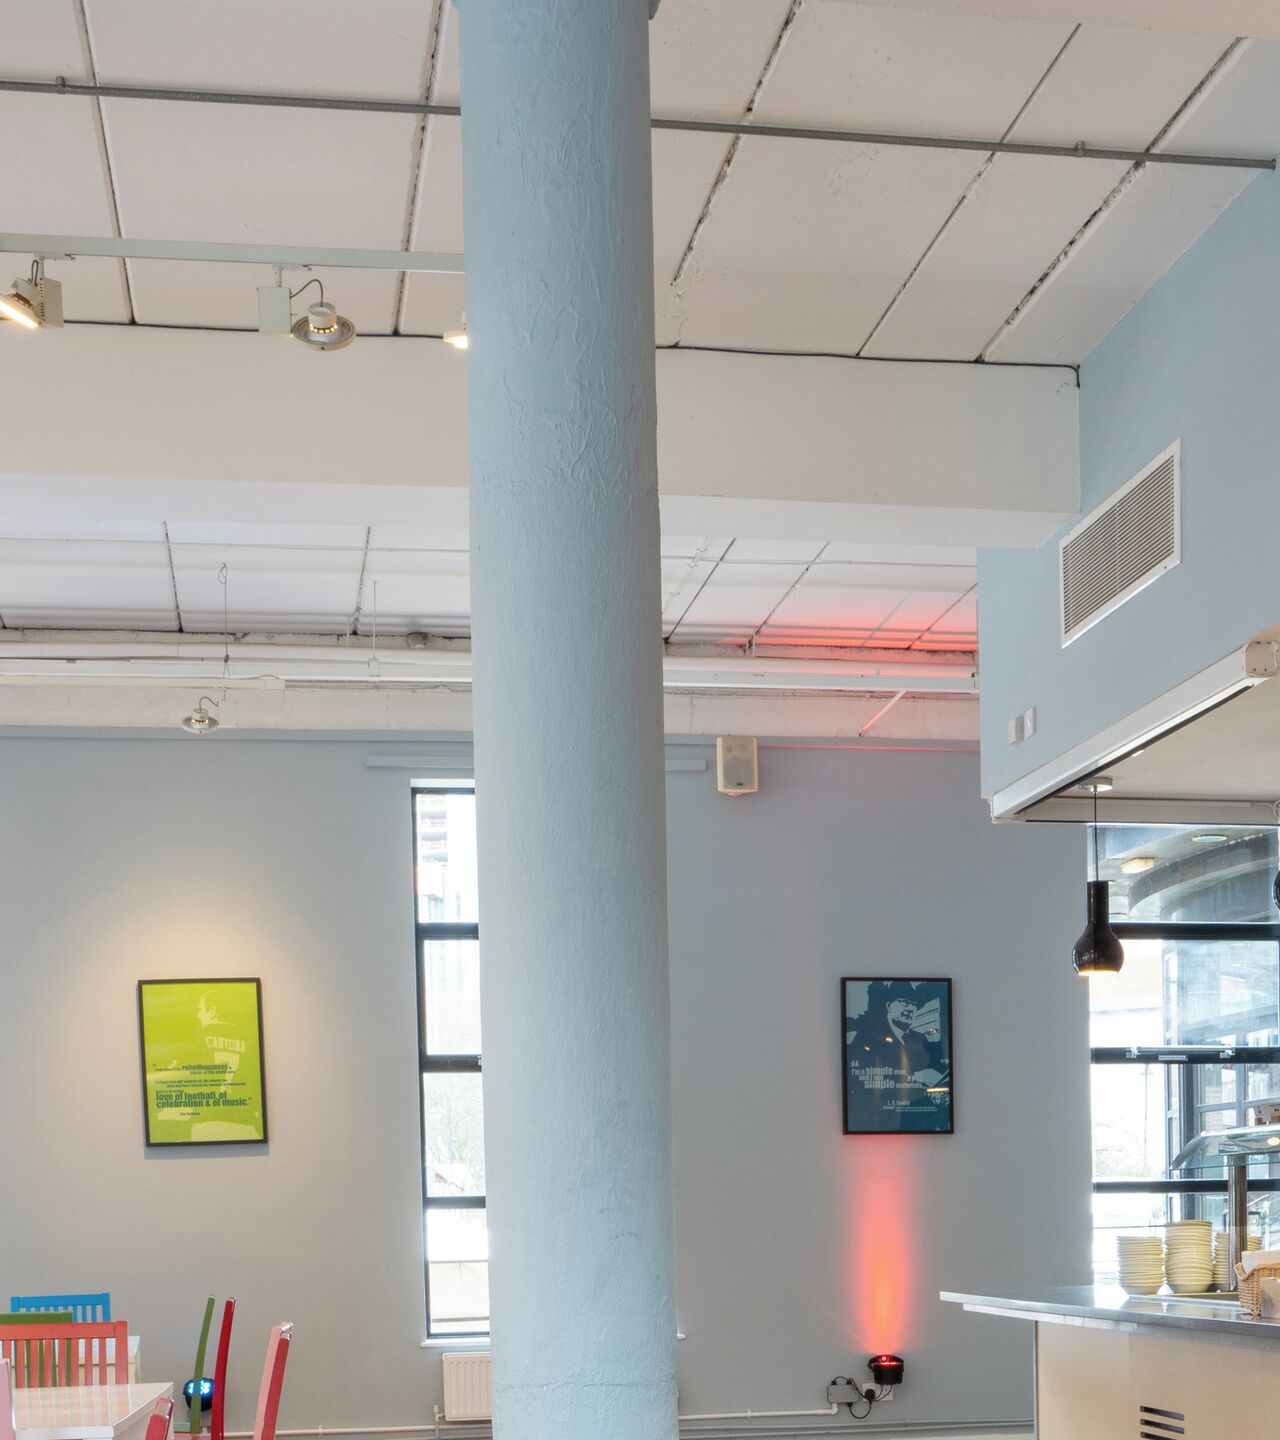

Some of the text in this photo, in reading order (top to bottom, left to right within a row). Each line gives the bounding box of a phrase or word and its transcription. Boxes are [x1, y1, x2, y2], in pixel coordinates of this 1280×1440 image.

[204, 1036, 246, 1053] CANTONA
[214, 1051, 240, 1094] 7
[865, 1066, 893, 1076] simple
[864, 1079, 895, 1090] simple
[156, 1091, 174, 1101] love
[175, 1091, 183, 1100] of
[219, 1091, 227, 1100] of
[156, 1099, 204, 1108] celebration
[212, 1099, 221, 1107] of
